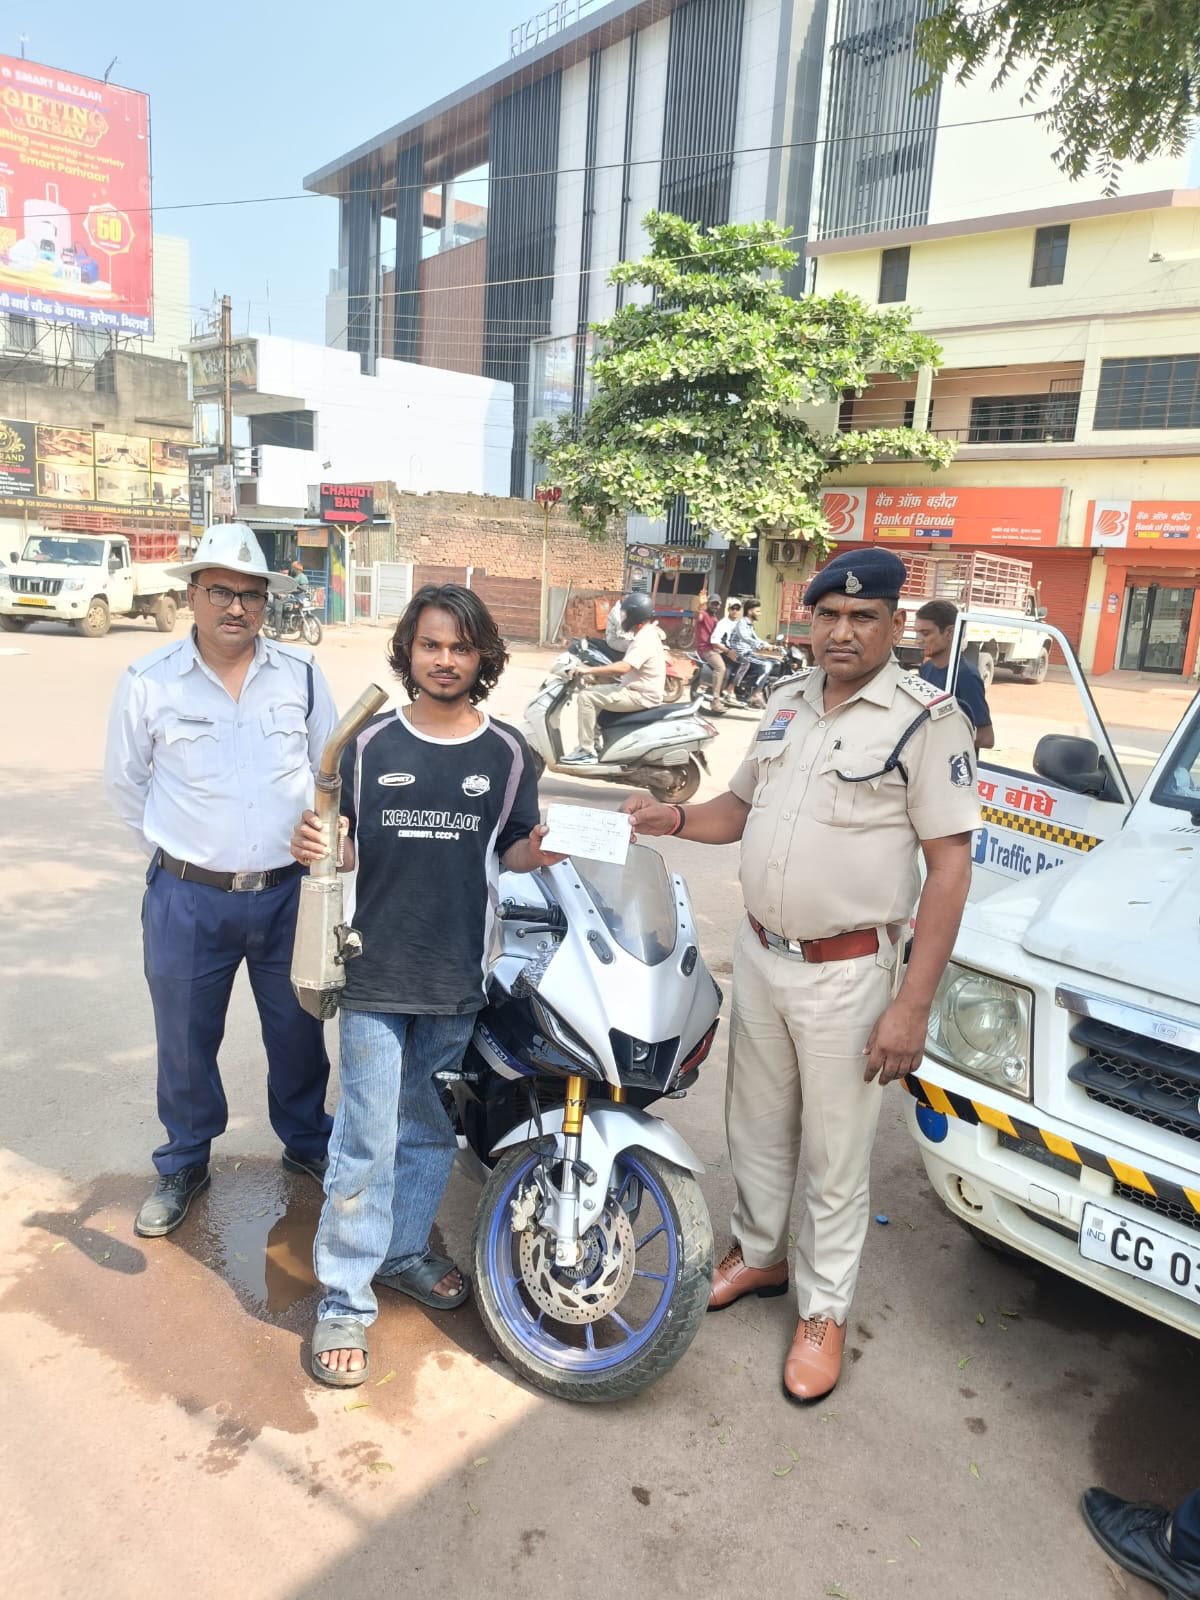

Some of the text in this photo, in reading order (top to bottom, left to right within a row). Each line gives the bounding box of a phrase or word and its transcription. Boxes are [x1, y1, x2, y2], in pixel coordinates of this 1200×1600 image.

[15, 71, 103, 102] SMART BAZAAR
[3, 88, 103, 127] GIFTING
[321, 484, 373, 498] CHARIOT
[334, 496, 360, 509] BAR
[873, 512, 955, 526] Bank of Baroda
[1162, 523, 1190, 532] Baroda
[990, 836, 1032, 875] Traffic
[1086, 1228, 1106, 1242] IND
[1110, 1227, 1154, 1271] CG
